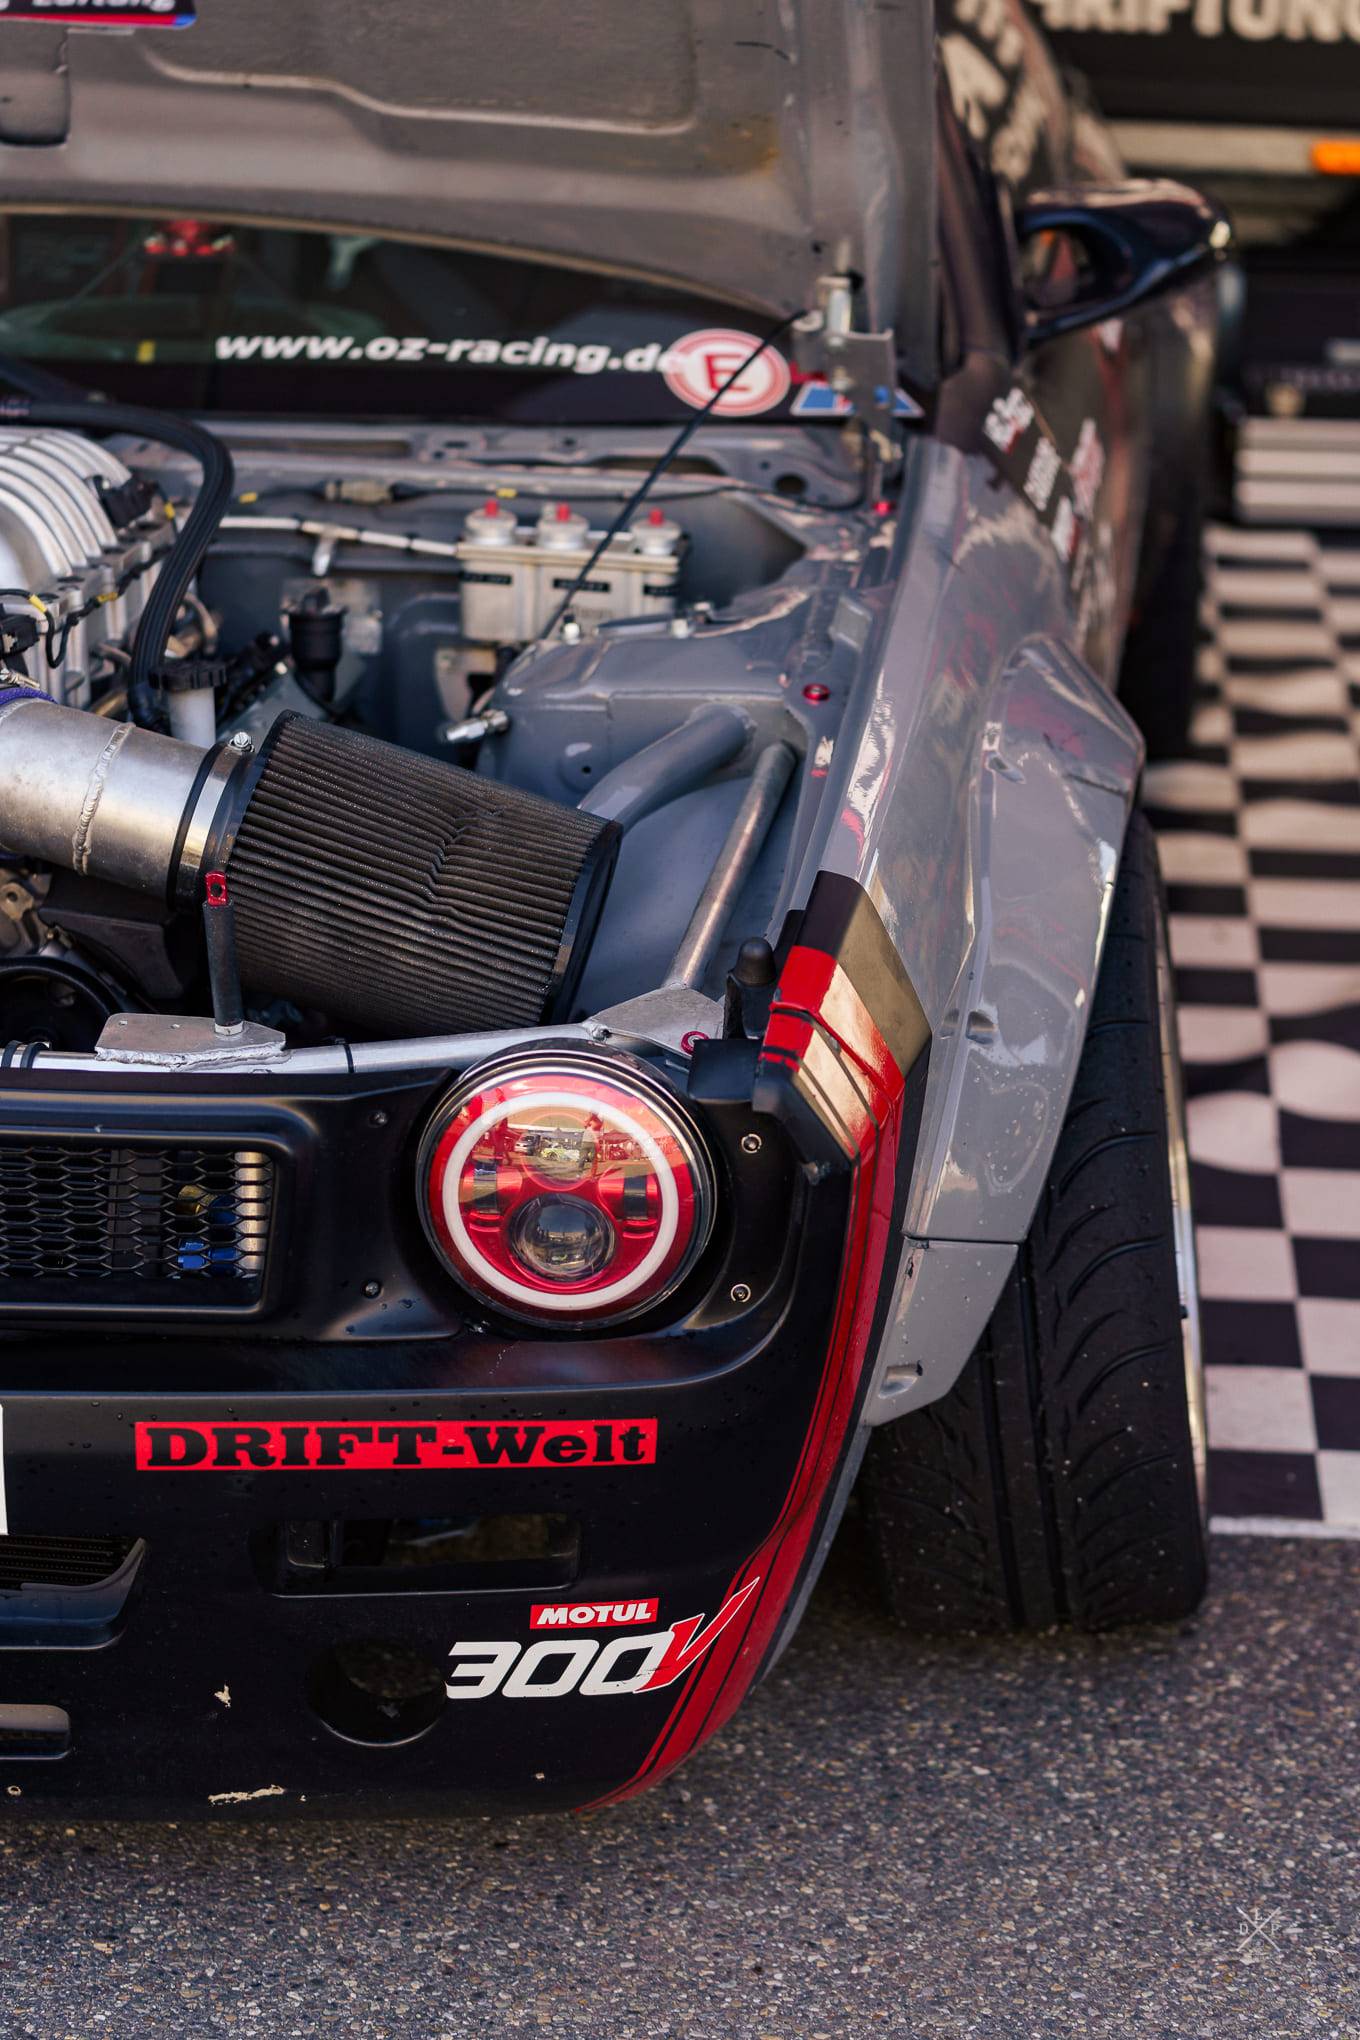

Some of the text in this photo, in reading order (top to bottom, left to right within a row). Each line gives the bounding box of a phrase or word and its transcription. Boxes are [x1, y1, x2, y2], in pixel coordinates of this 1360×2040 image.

[703, 353, 751, 393] E
[146, 1424, 647, 1467] DRIFT-Welt
[536, 1602, 651, 1625] MOTUL
[444, 1576, 761, 1699] 300V
